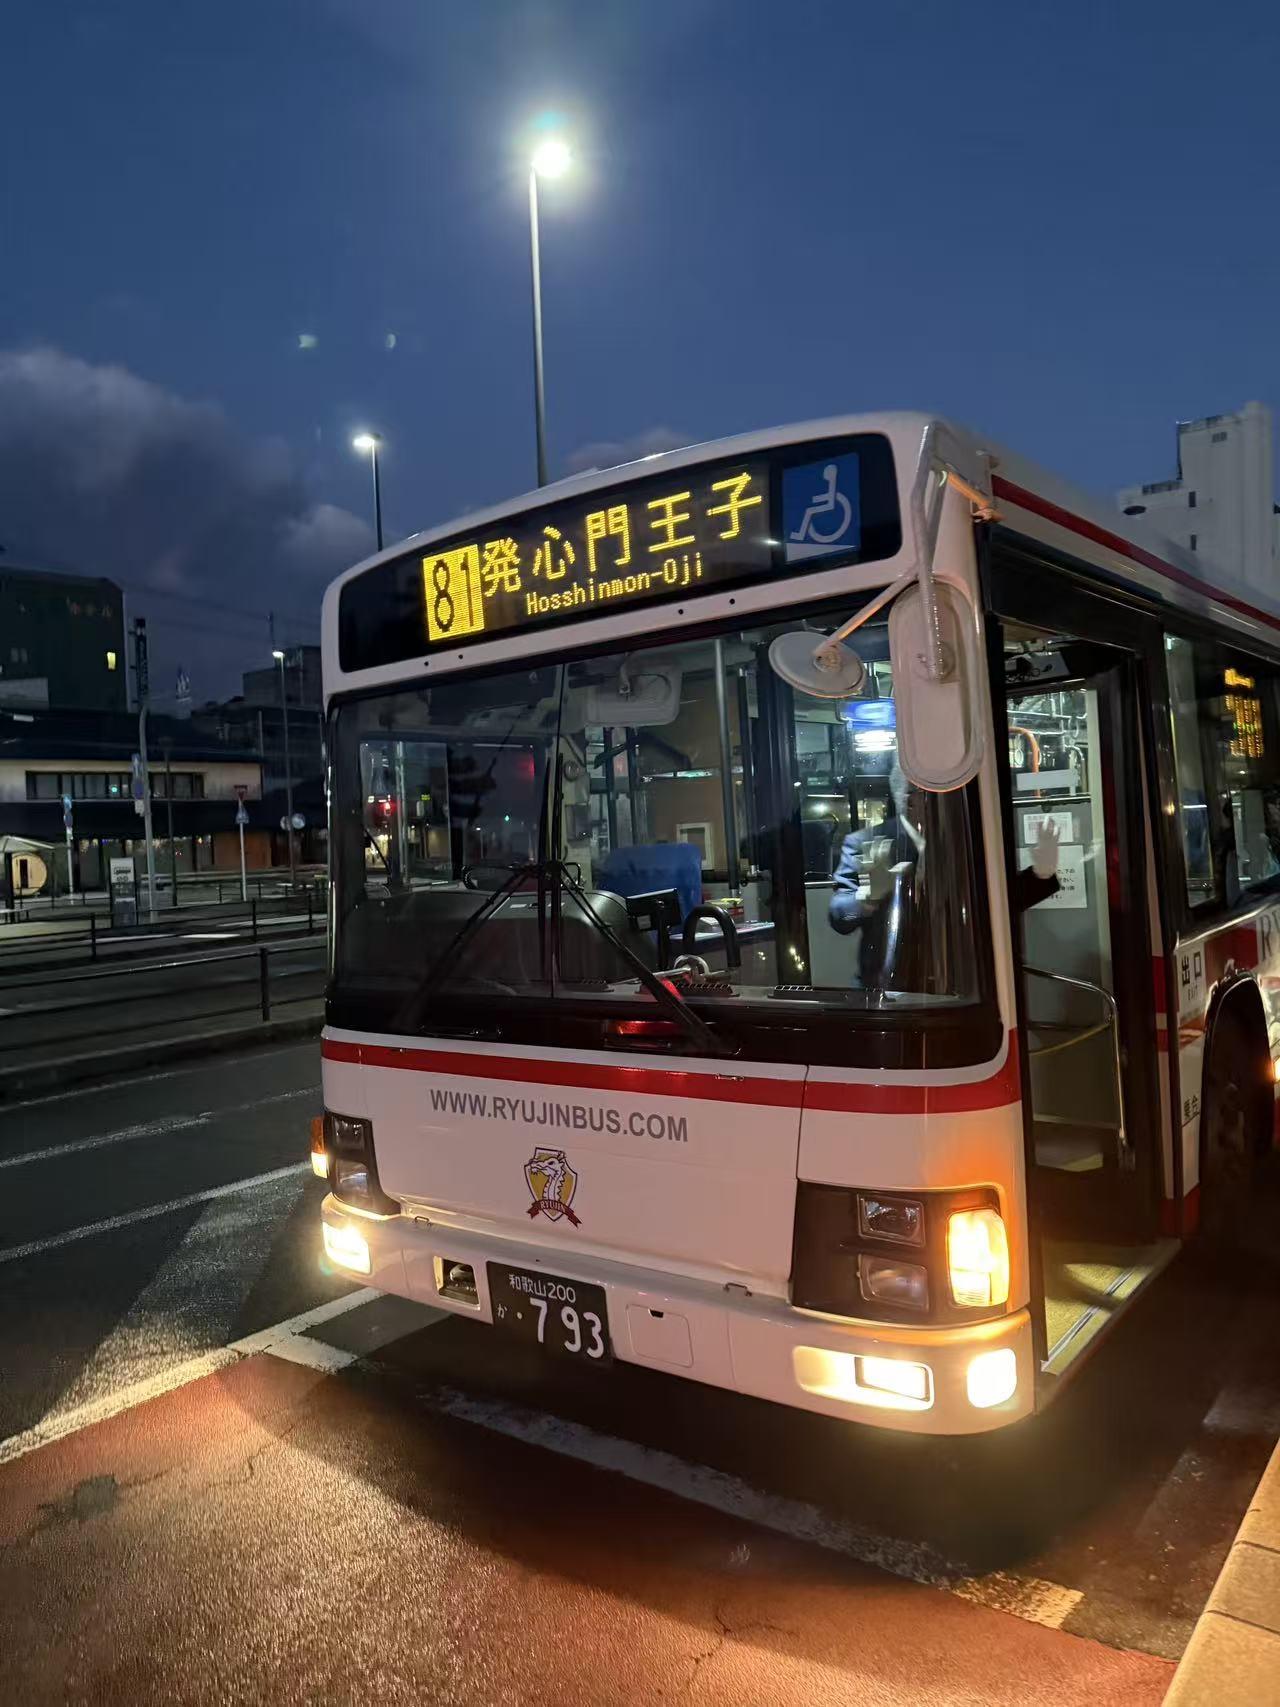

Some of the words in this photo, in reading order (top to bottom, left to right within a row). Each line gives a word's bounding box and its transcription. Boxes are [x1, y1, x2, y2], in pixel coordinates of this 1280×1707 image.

[482, 472, 762, 598] 発心門王子
[431, 551, 475, 633] 81
[526, 552, 703, 616] Hosshinmon-Oji
[1182, 951, 1202, 987] 出口
[430, 1089, 689, 1143] WWW.RYUJINBUS.COM
